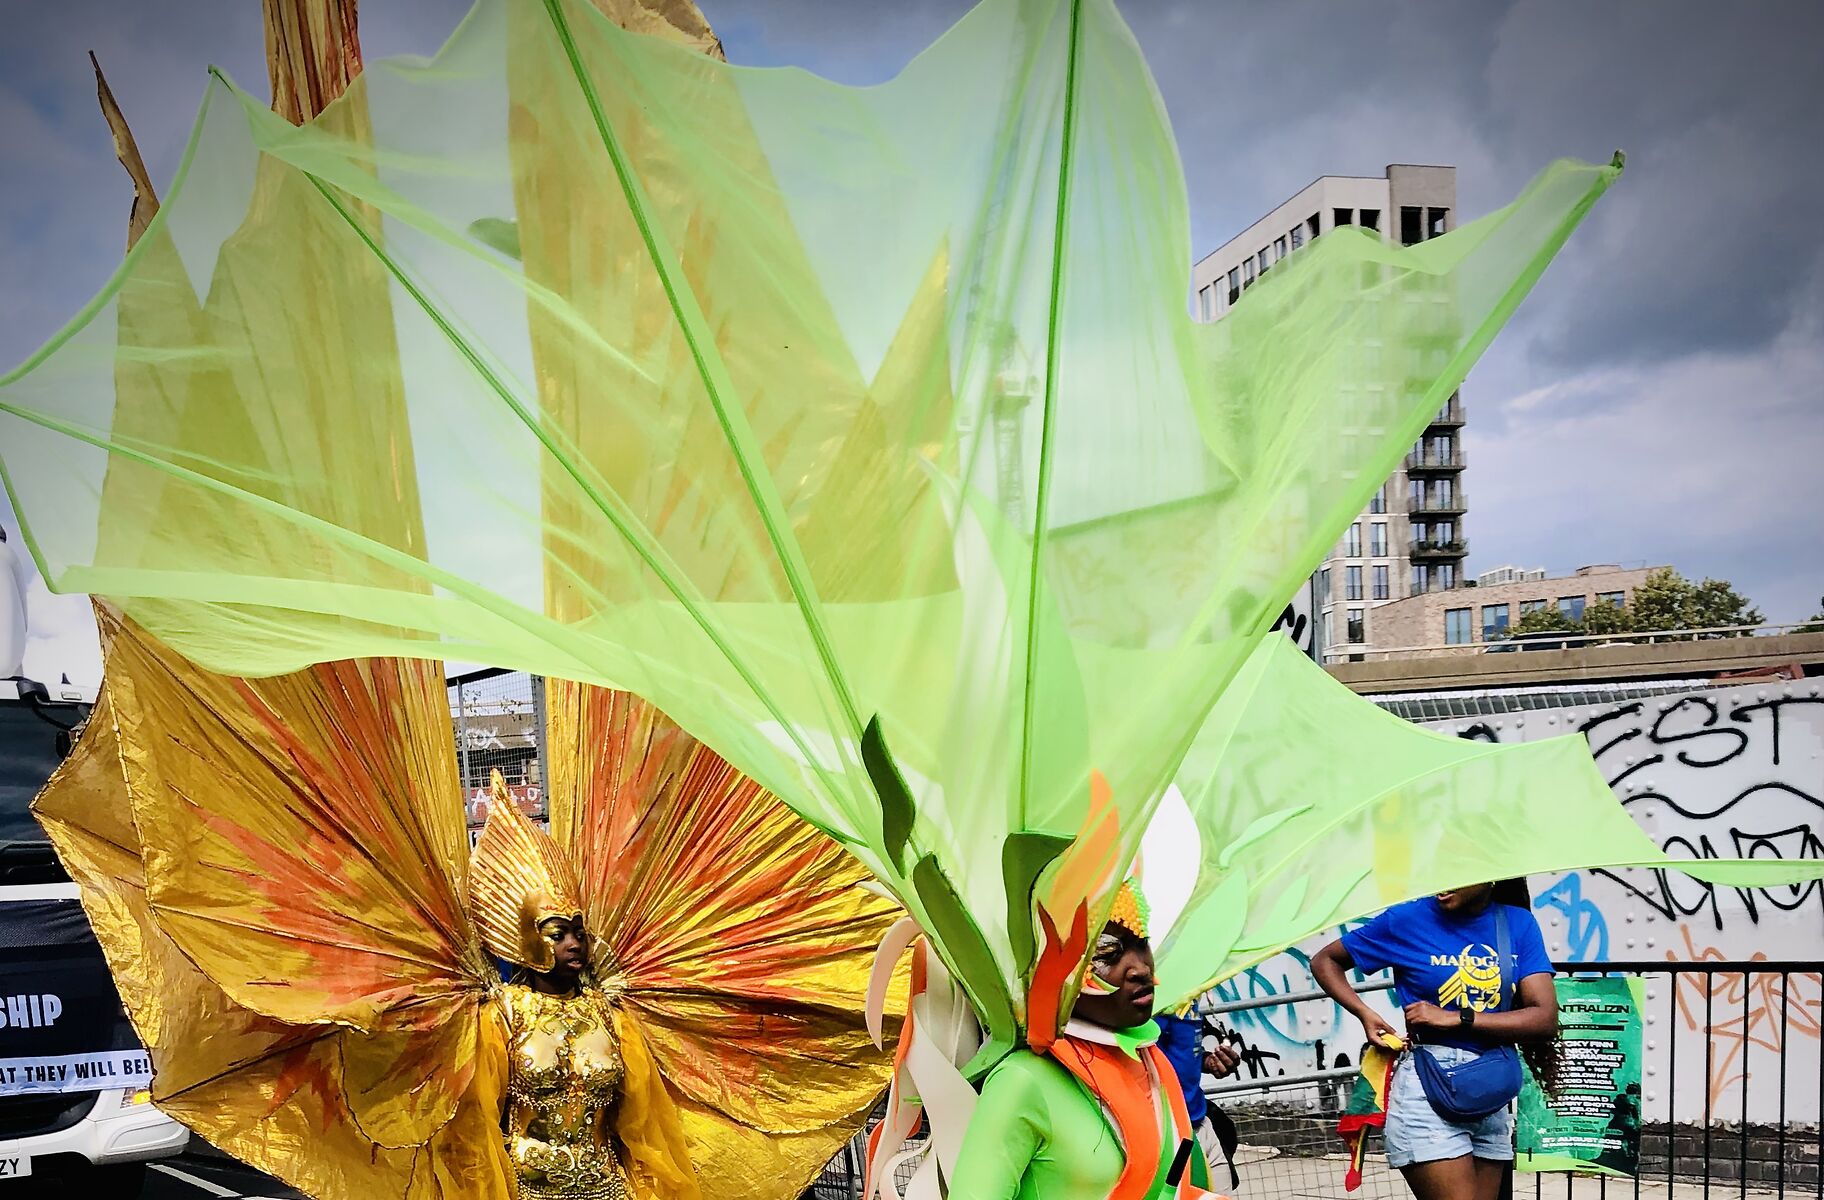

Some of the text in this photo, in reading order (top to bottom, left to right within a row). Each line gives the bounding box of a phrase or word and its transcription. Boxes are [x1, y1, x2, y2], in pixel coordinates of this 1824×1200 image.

[25, 1064, 67, 1083] THEY
[75, 1060, 116, 1079] WILL
[123, 1058, 150, 1075] BE!
